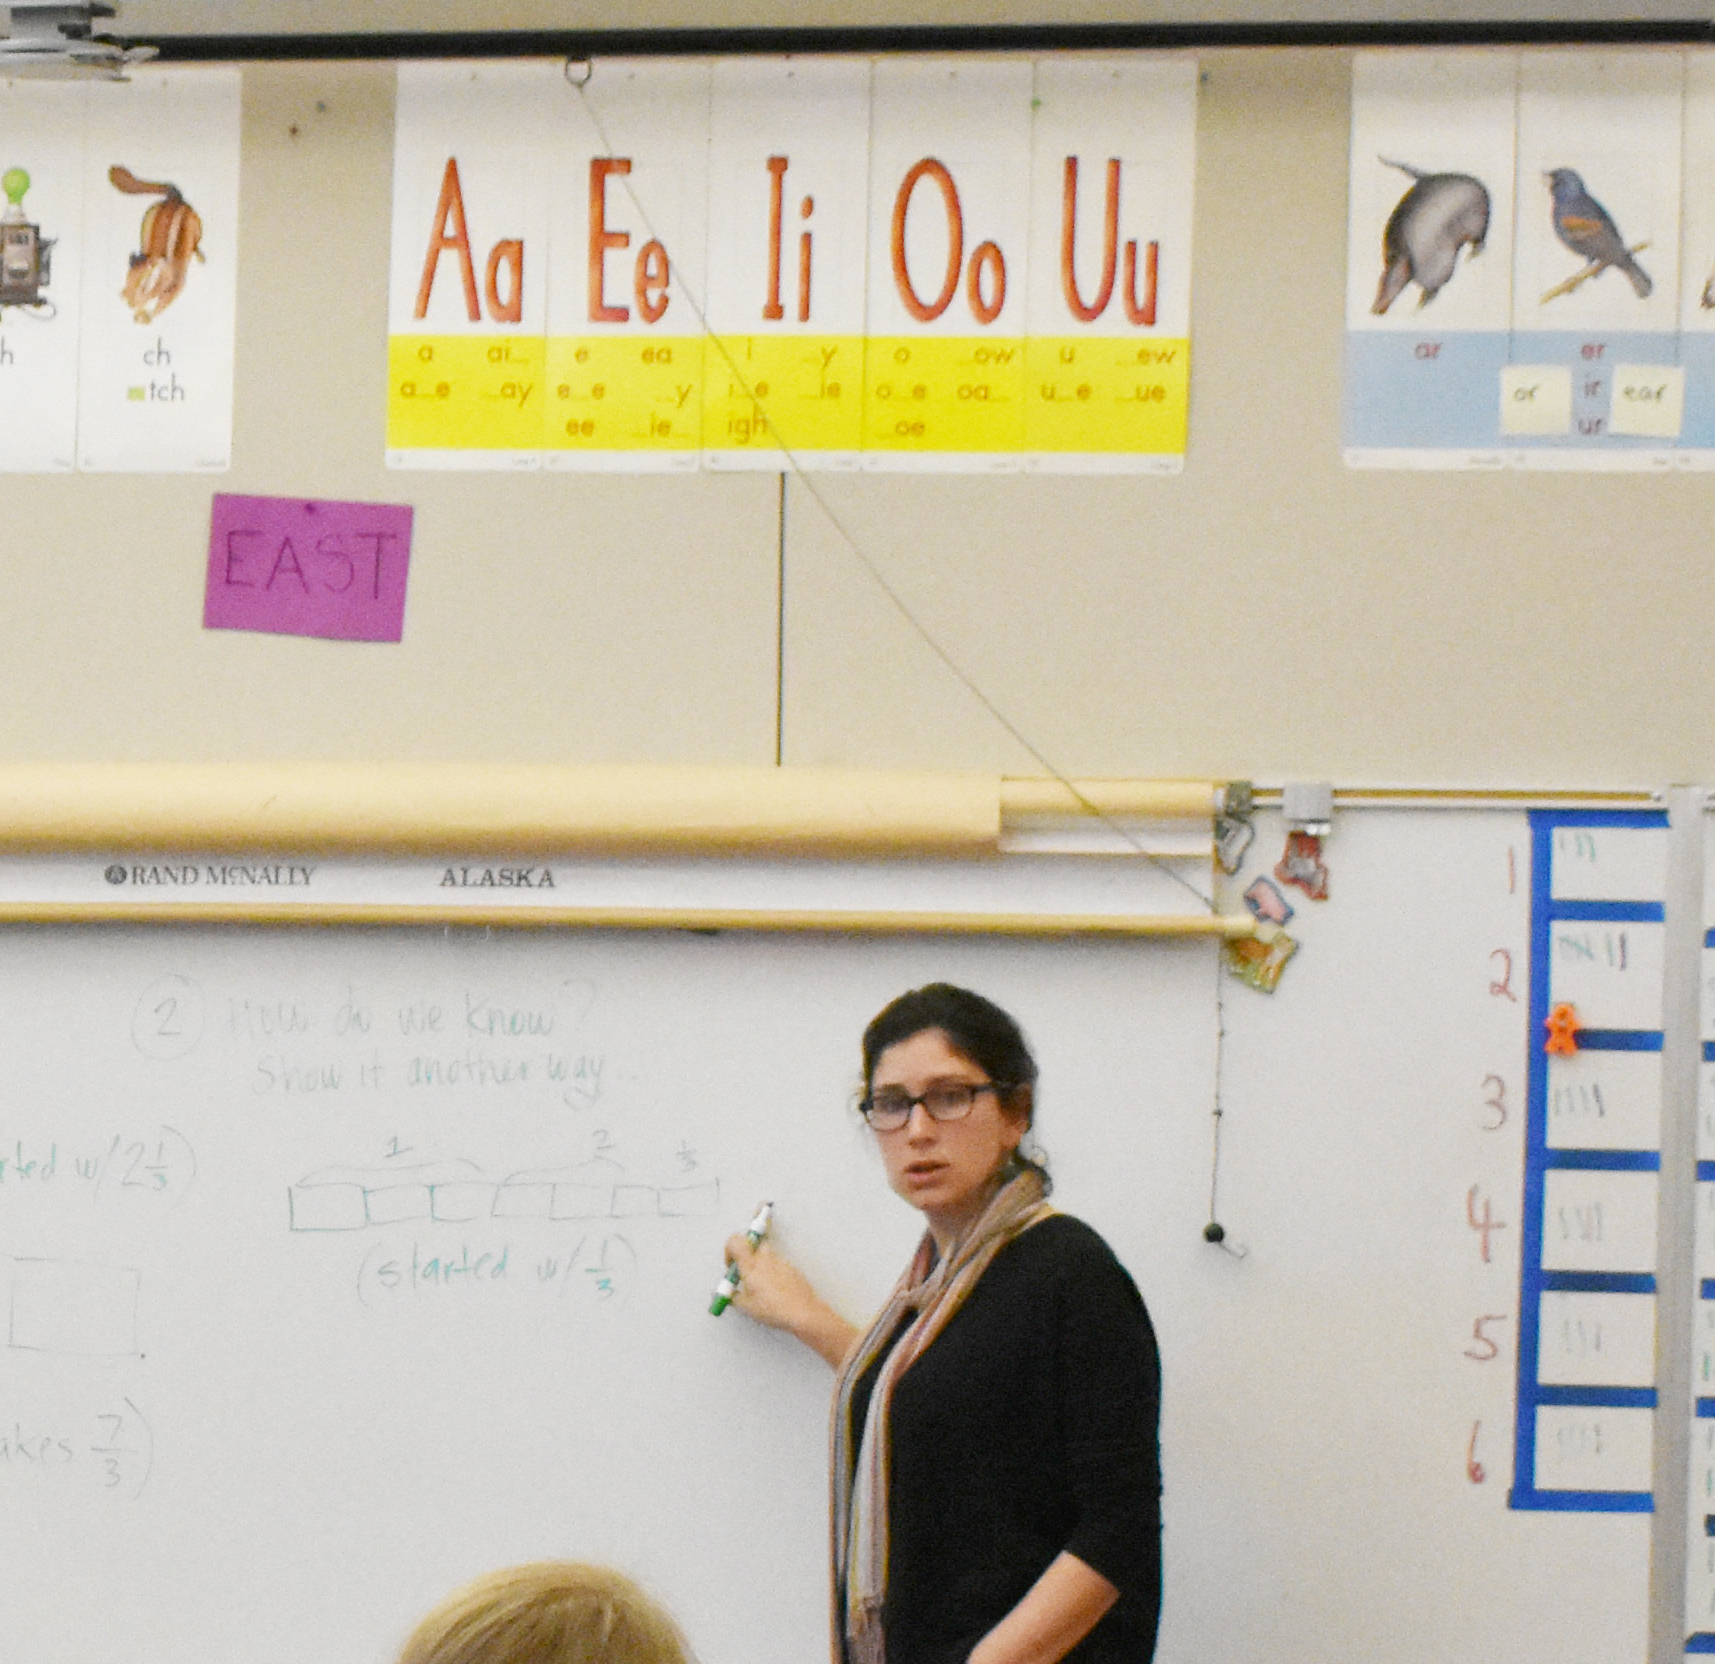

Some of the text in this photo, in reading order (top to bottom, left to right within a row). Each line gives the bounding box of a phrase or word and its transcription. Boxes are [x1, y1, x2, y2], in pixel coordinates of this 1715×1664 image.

[414, 157, 524, 323] Aa
[589, 155, 671, 324] Ee
[764, 155, 814, 323] Ii
[892, 157, 1006, 325] Oo
[1061, 155, 1158, 326] Uu
[143, 342, 172, 366] ch
[418, 345, 434, 363] a
[575, 347, 588, 363] e
[641, 346, 672, 364] ea
[149, 379, 186, 403] tch
[566, 419, 595, 437] ee
[225, 529, 398, 600] EAST
[132, 866, 199, 885] RAND
[439, 868, 556, 889] ALASKA
[1508, 844, 1516, 894] 1
[1489, 948, 1517, 1002] 2
[399, 998, 443, 1034] we
[360, 1053, 386, 1090] it
[407, 1055, 533, 1087] another
[1481, 1075, 1507, 1130] 3
[1466, 1183, 1506, 1263] 4
[1464, 1315, 1507, 1360] 5
[1467, 1421, 1485, 1484] 6
